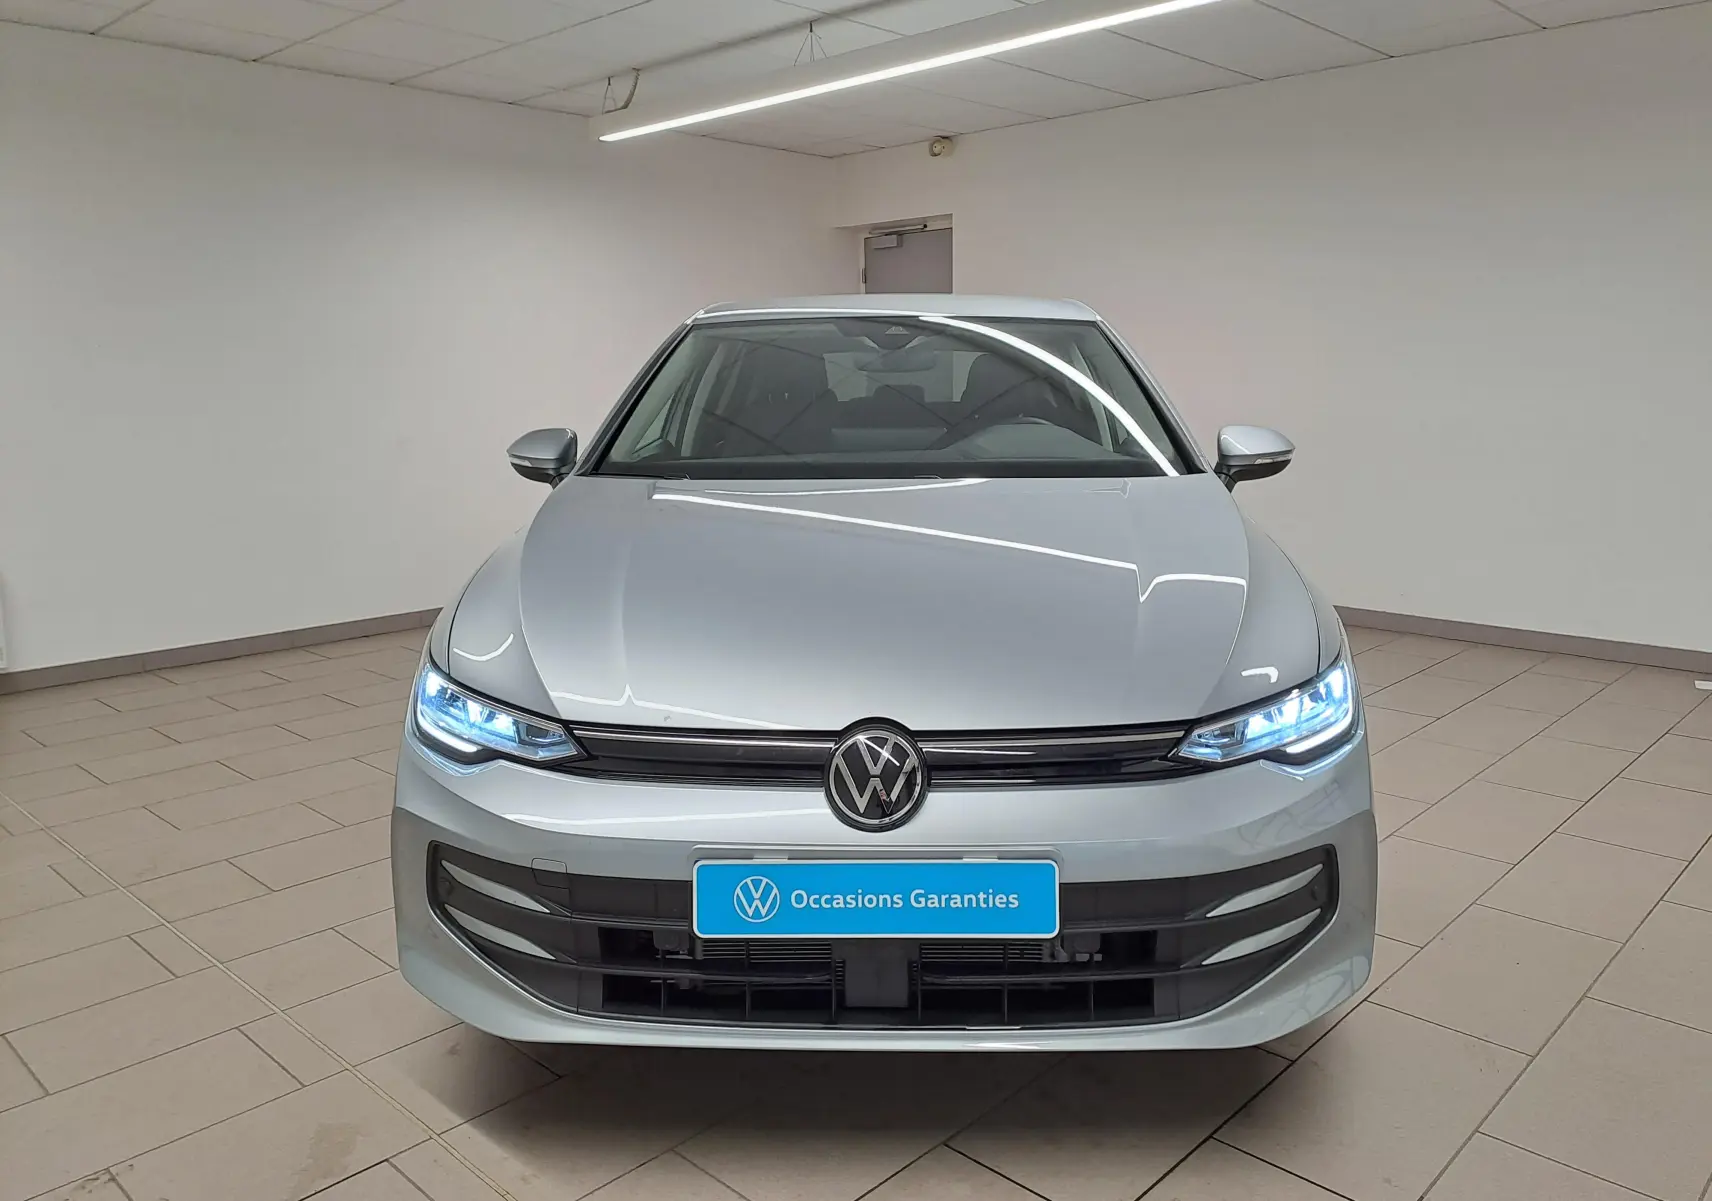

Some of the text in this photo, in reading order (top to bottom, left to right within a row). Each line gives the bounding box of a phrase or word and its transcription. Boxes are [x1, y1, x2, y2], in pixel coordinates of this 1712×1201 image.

[832, 733, 920, 819] VW
[735, 877, 1019, 921] VW Occasions Garanties
